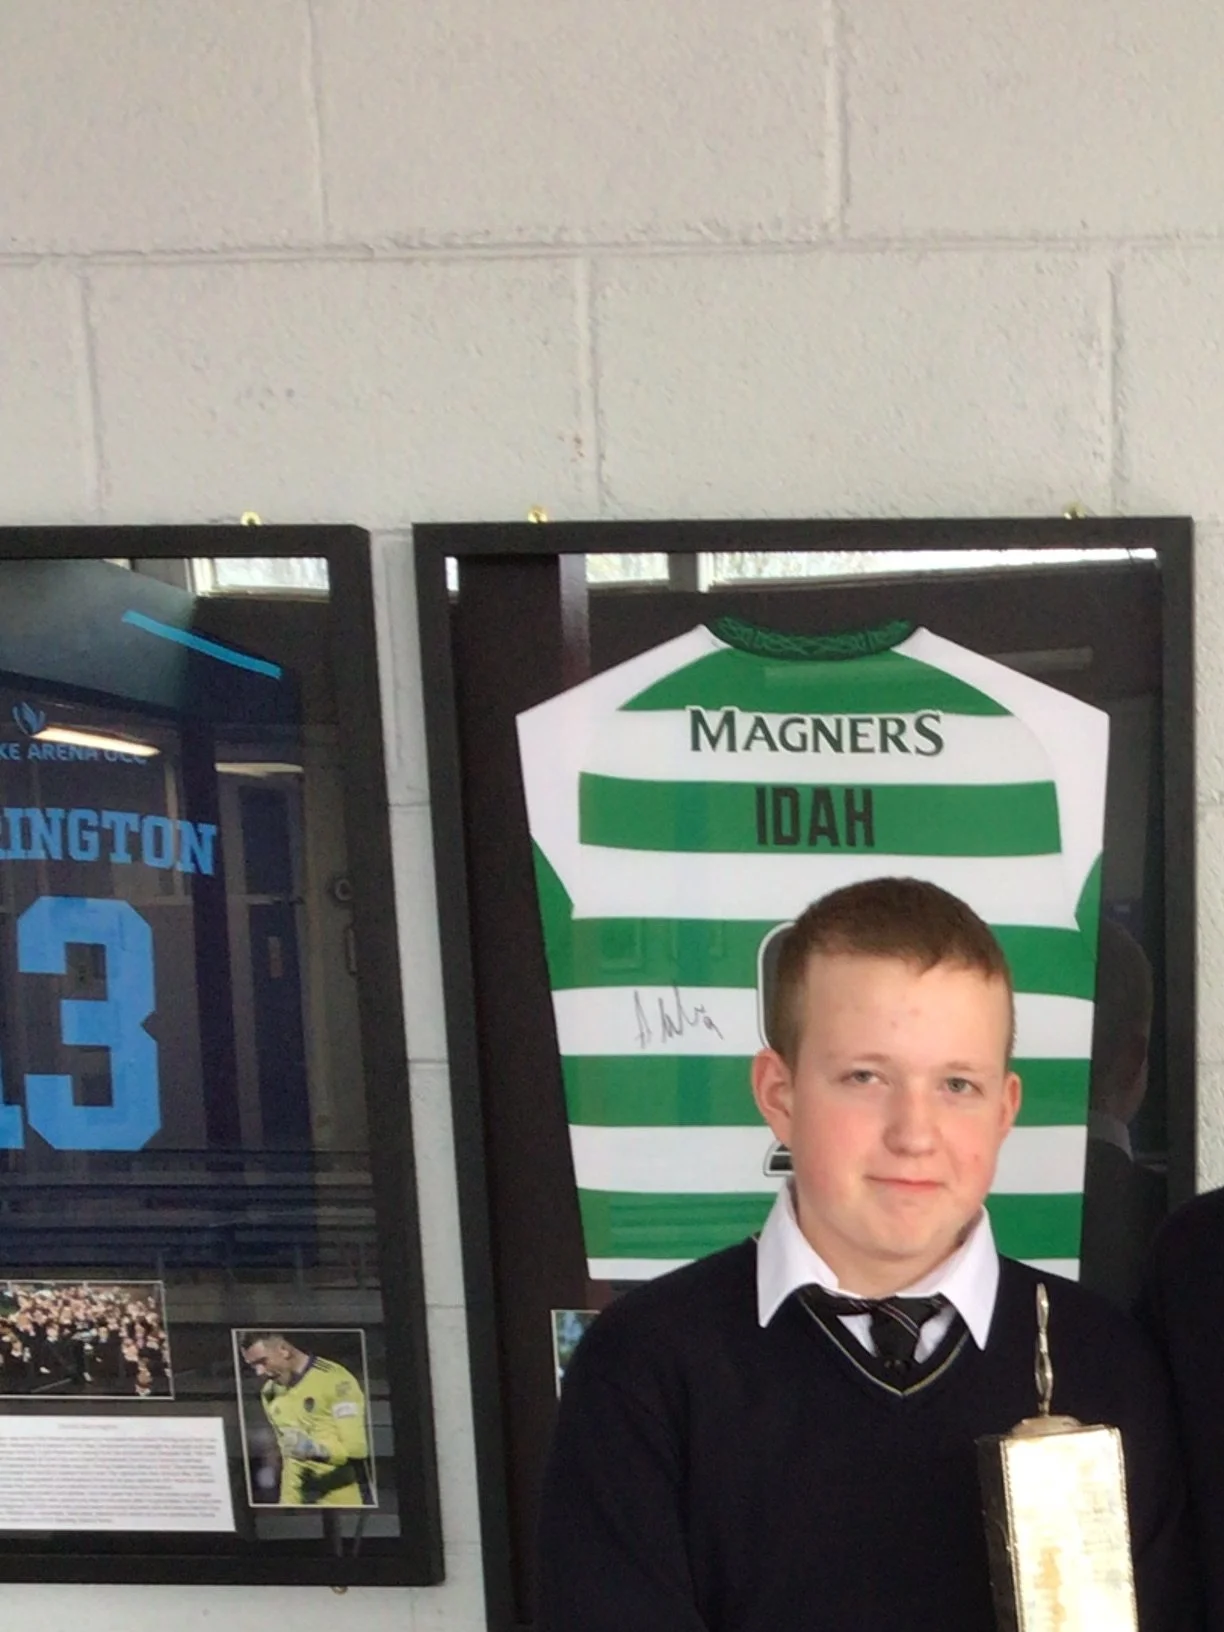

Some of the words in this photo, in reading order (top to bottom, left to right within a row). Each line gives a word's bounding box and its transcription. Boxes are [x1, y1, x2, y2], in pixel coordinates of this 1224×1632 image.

[689, 705, 944, 757] MAGNERS
[0, 807, 217, 876] INGTON
[754, 786, 876, 848] IDAH
[0, 895, 162, 1151] 3
